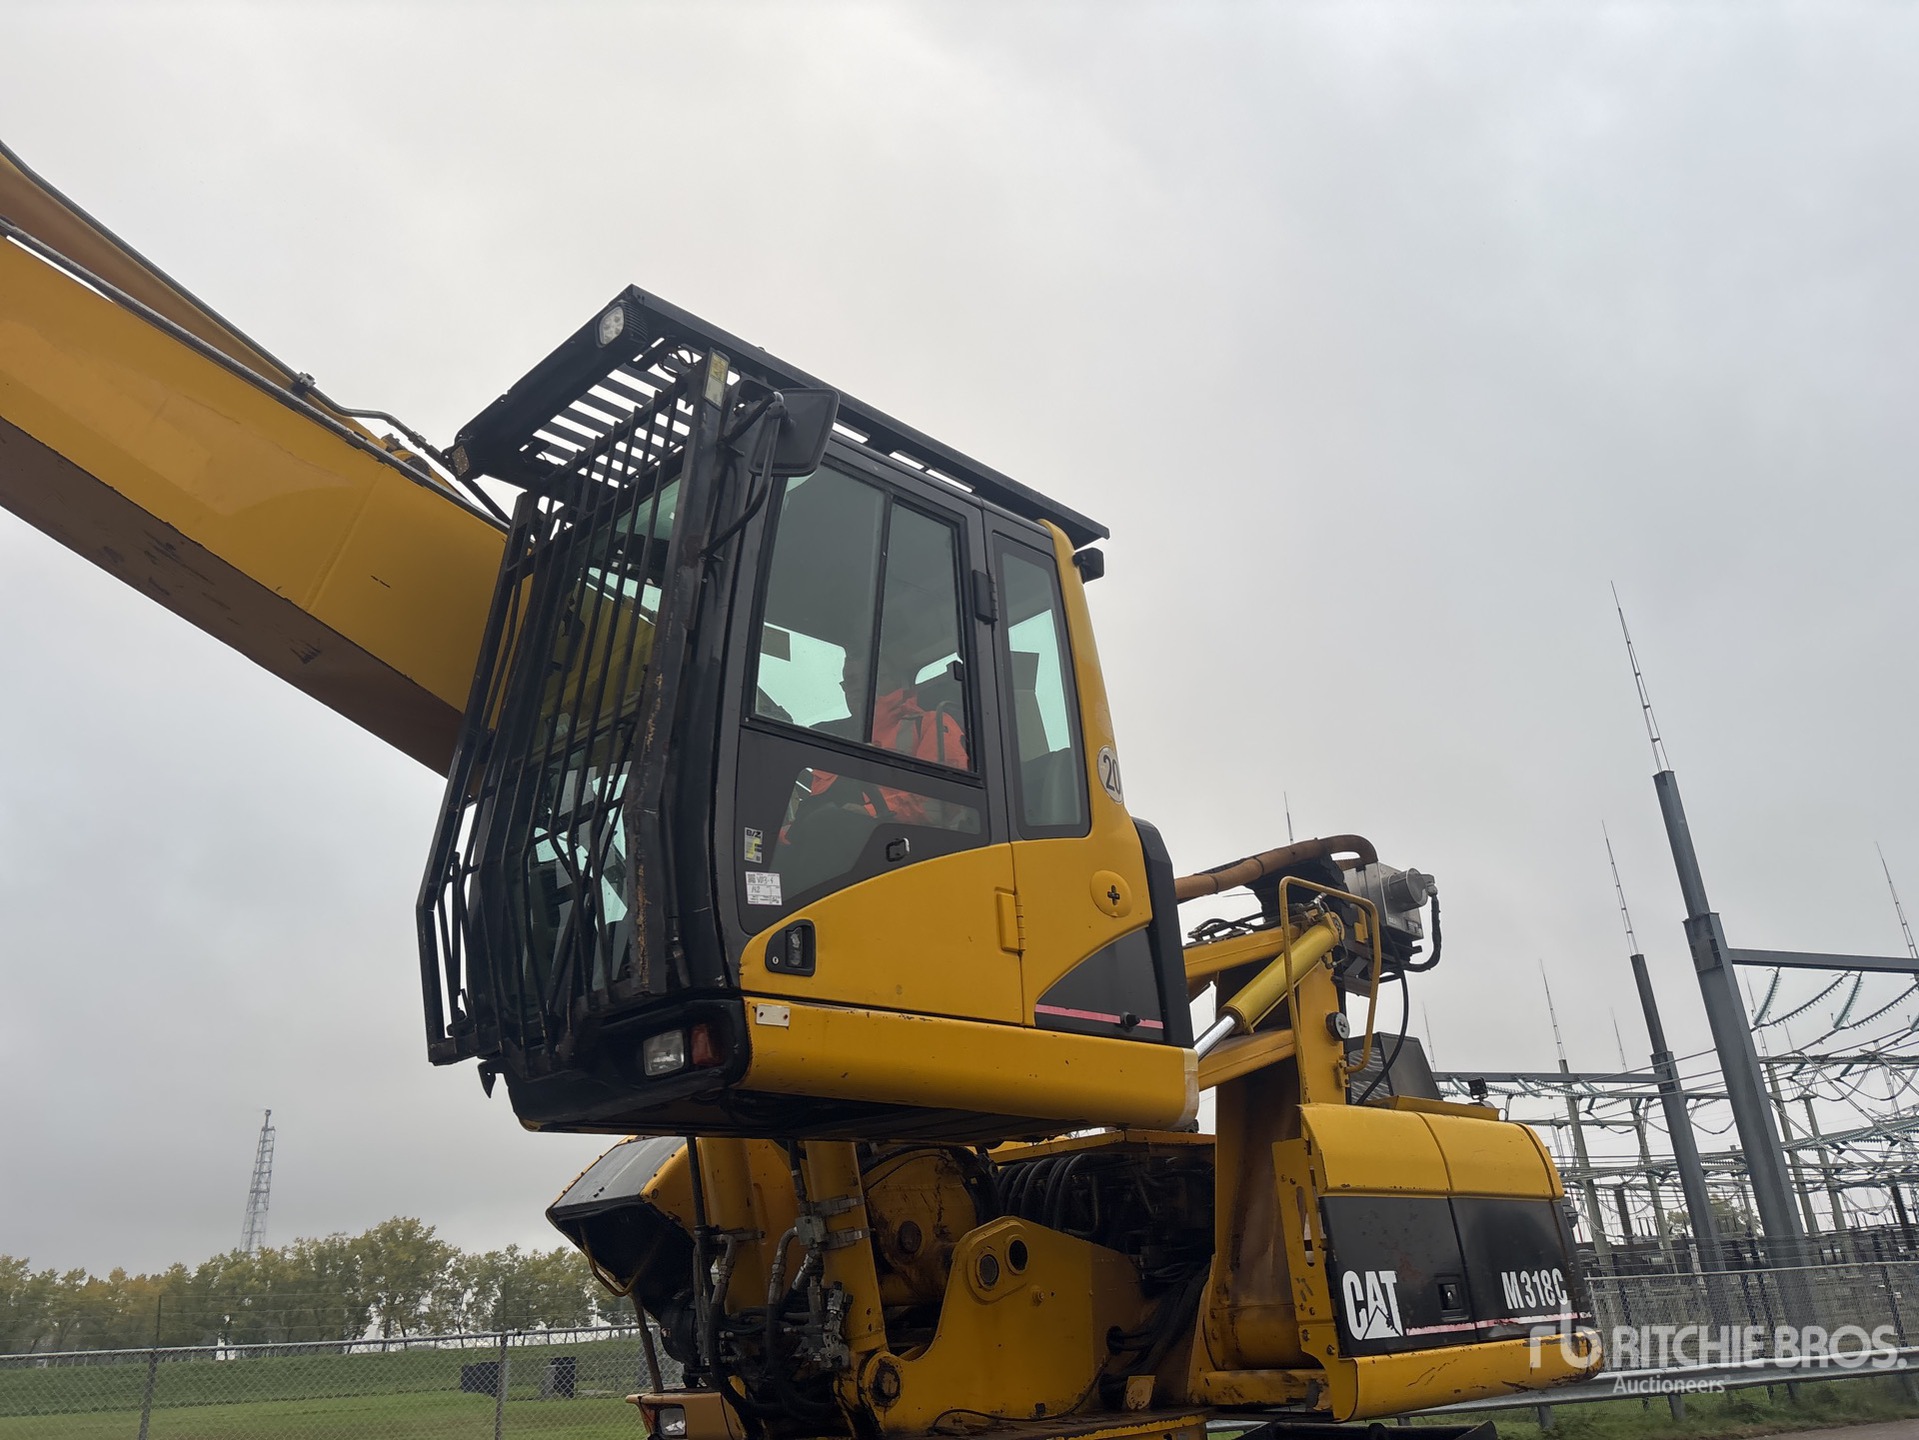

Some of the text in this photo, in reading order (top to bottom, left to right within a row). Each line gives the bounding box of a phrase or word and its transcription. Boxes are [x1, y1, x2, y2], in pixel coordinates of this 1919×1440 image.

[1102, 754, 1121, 795] 20
[1342, 1270, 1404, 1341] CAT
[1501, 1267, 1569, 1310] M318C
